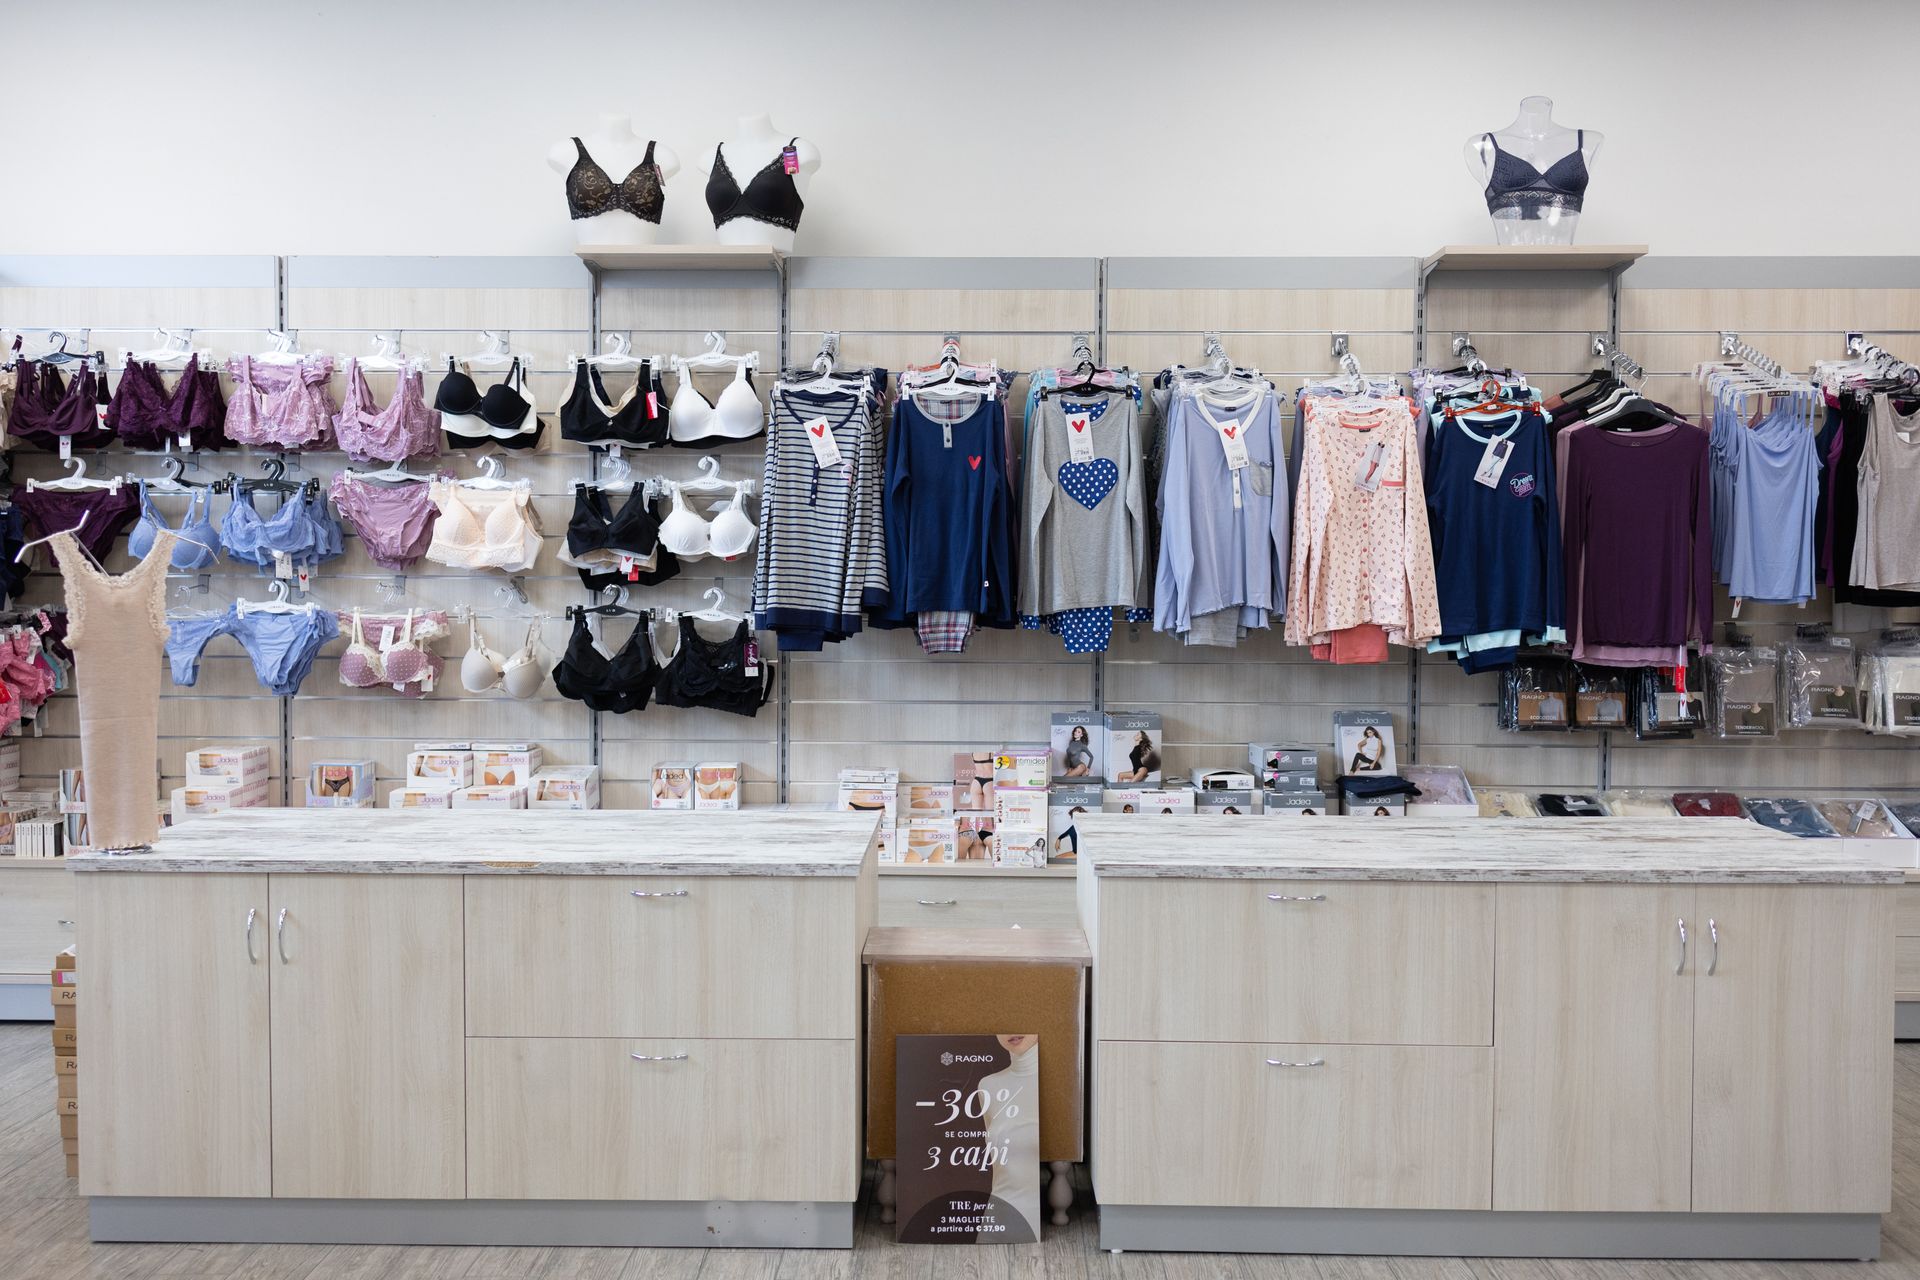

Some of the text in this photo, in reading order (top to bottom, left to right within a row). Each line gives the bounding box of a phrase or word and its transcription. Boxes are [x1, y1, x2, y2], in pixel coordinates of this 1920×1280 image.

[1065, 715, 1090, 723] Jadea
[1125, 720, 1150, 728] Jadea
[1063, 796, 1089, 804] Jadea
[1155, 796, 1180, 804] Jadea
[1212, 795, 1237, 804] Jadea
[1286, 797, 1312, 805] Jadea
[1366, 796, 1391, 804] Jadea
[955, 1055, 994, 1063] RAGNO
[923, 1138, 1010, 1171] 3 capi
[949, 1201, 971, 1210] TRE
[973, 1203, 987, 1211] per
[936, 1225, 963, 1234] partire
[983, 1225, 1006, 1233] 37,90
